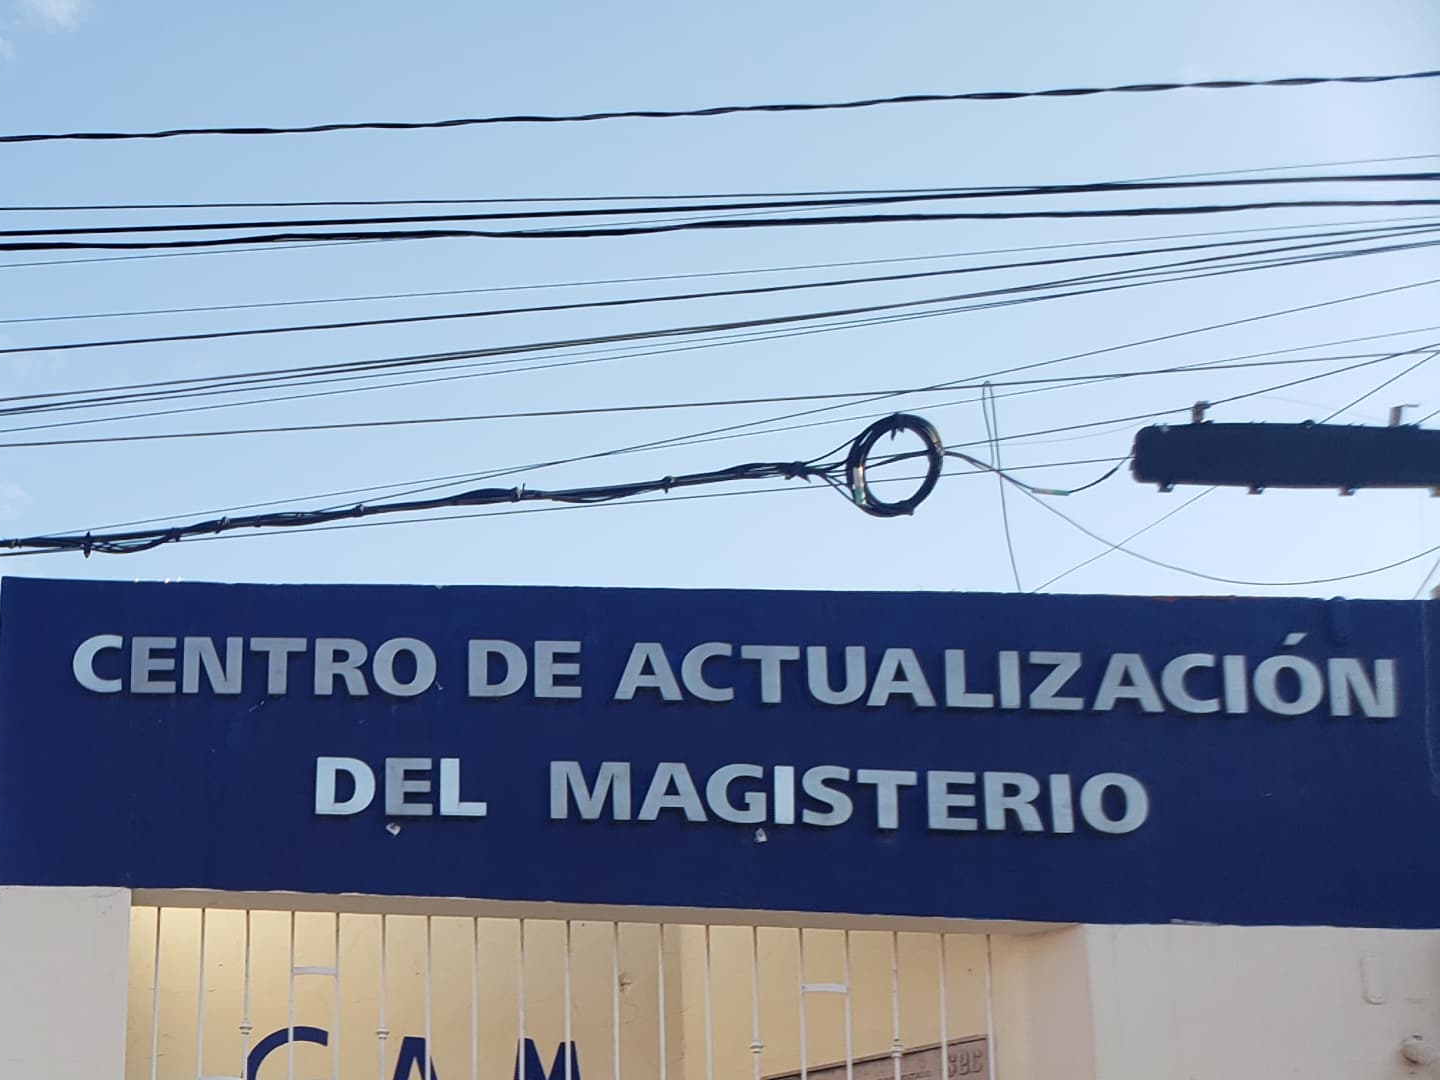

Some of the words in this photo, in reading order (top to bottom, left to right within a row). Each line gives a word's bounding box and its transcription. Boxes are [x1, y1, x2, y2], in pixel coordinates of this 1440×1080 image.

[72, 634, 438, 697] CENTRO
[467, 639, 583, 699] DE
[613, 632, 1398, 719] ACTUALIZACIÓN
[314, 756, 488, 818] DEL
[548, 760, 1150, 835] MAGISTERIO
